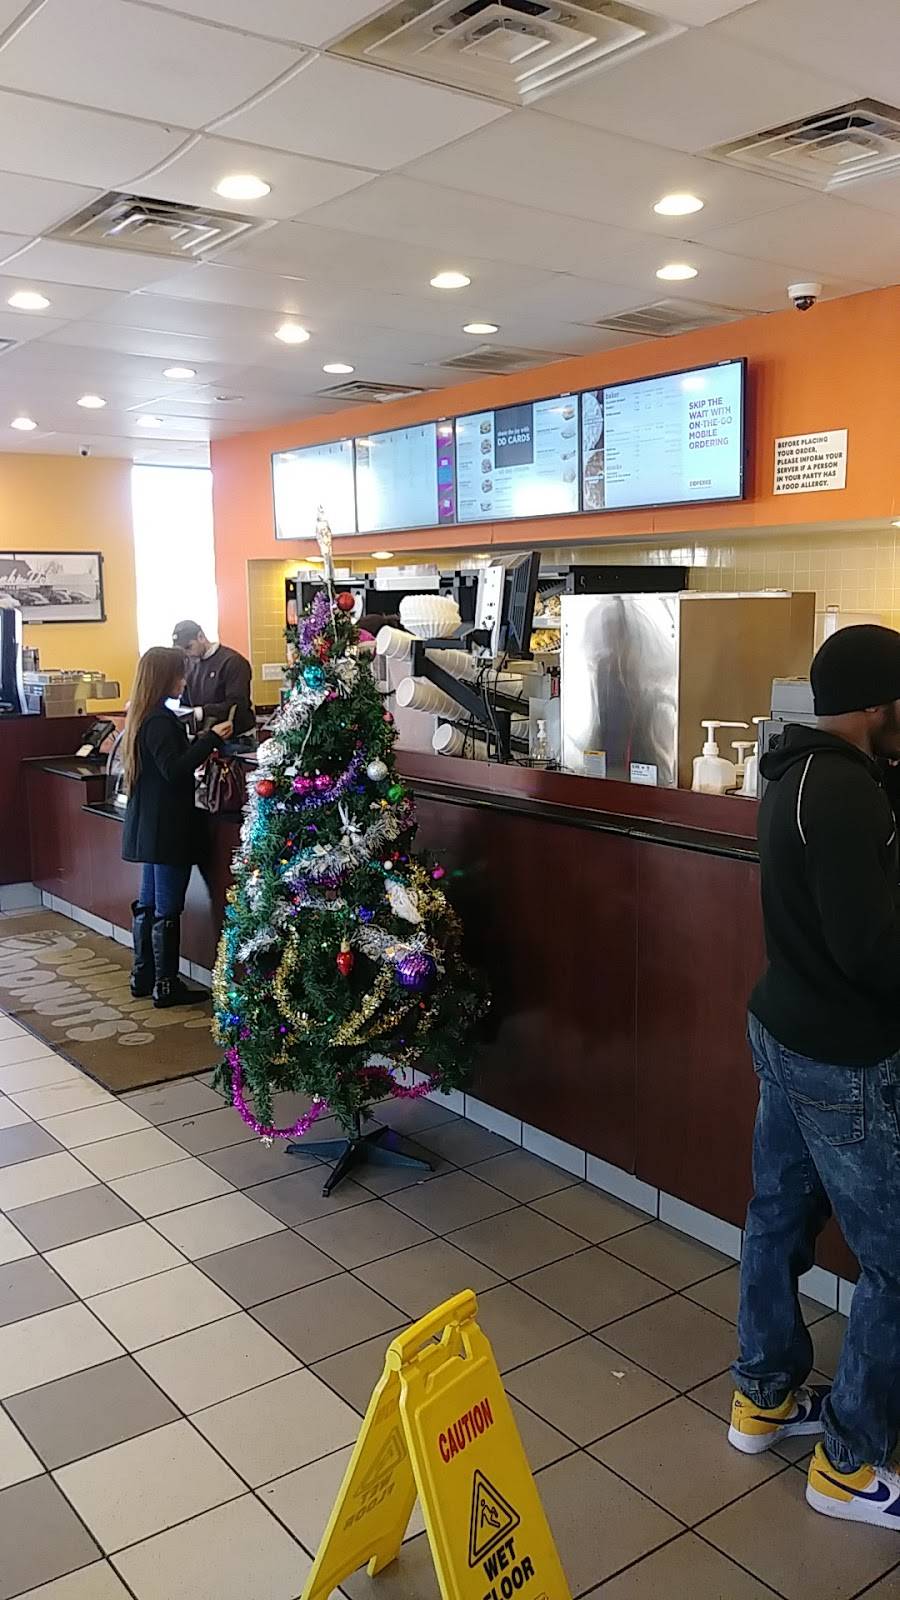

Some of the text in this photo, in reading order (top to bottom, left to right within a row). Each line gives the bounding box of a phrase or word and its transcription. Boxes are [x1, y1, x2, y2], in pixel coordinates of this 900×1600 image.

[689, 400, 706, 410] SKIP
[707, 397, 723, 406] THE
[689, 407, 731, 420] WAIT WITH
[689, 416, 733, 430] ON-THE-GO
[508, 433, 531, 445] CARDS
[689, 429, 718, 440] MOBILE
[689, 437, 729, 450] ORDERING
[777, 436, 828, 448] BEFORE PLACING
[777, 449, 794, 457] YOUR
[777, 457, 798, 466] PLEASE
[825, 452, 843, 460] YOUR
[777, 466, 798, 474] SERVER
[813, 462, 838, 470] PERSON
[784, 474, 801, 482] YOUR
[802, 472, 822, 480] PARTY
[823, 470, 836, 478] HAS
[782, 483, 800, 491] FOOD
[438, 1397, 495, 1464] CAUTION
[483, 1537, 516, 1582] WET
